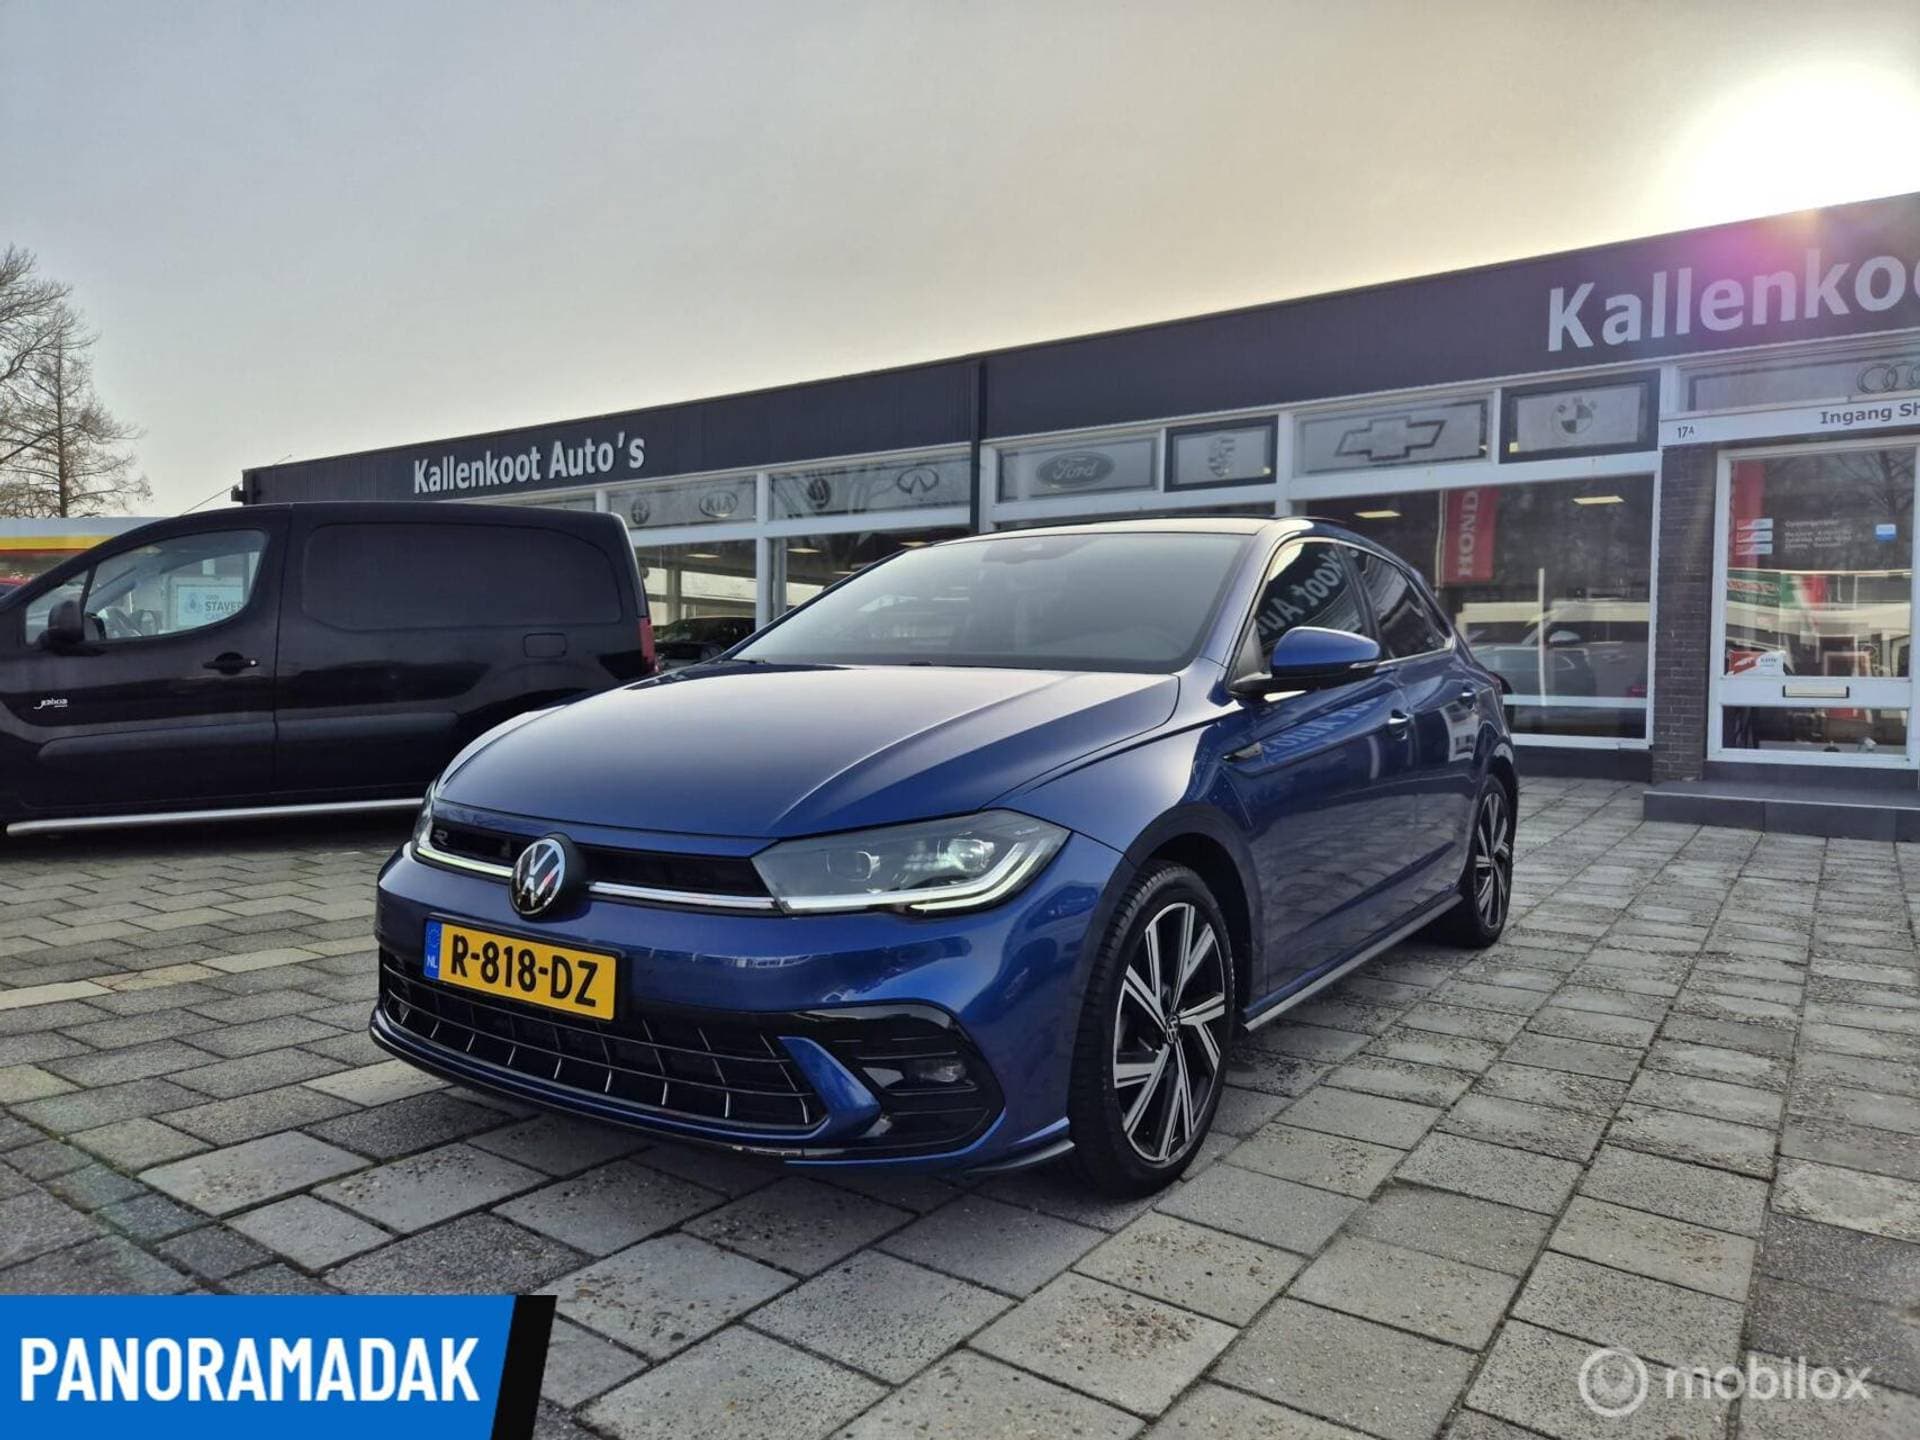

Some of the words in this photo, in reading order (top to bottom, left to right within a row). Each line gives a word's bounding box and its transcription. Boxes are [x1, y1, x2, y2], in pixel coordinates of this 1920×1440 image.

[1549, 248, 1920, 352] Kallenko
[1820, 408, 1892, 426] Ingang
[414, 446, 541, 494] Kallenkoot
[549, 431, 645, 480] Auto's
[1052, 458, 1099, 480] Ford
[426, 955, 438, 969] NL
[451, 934, 598, 1008] R-818-DZ
